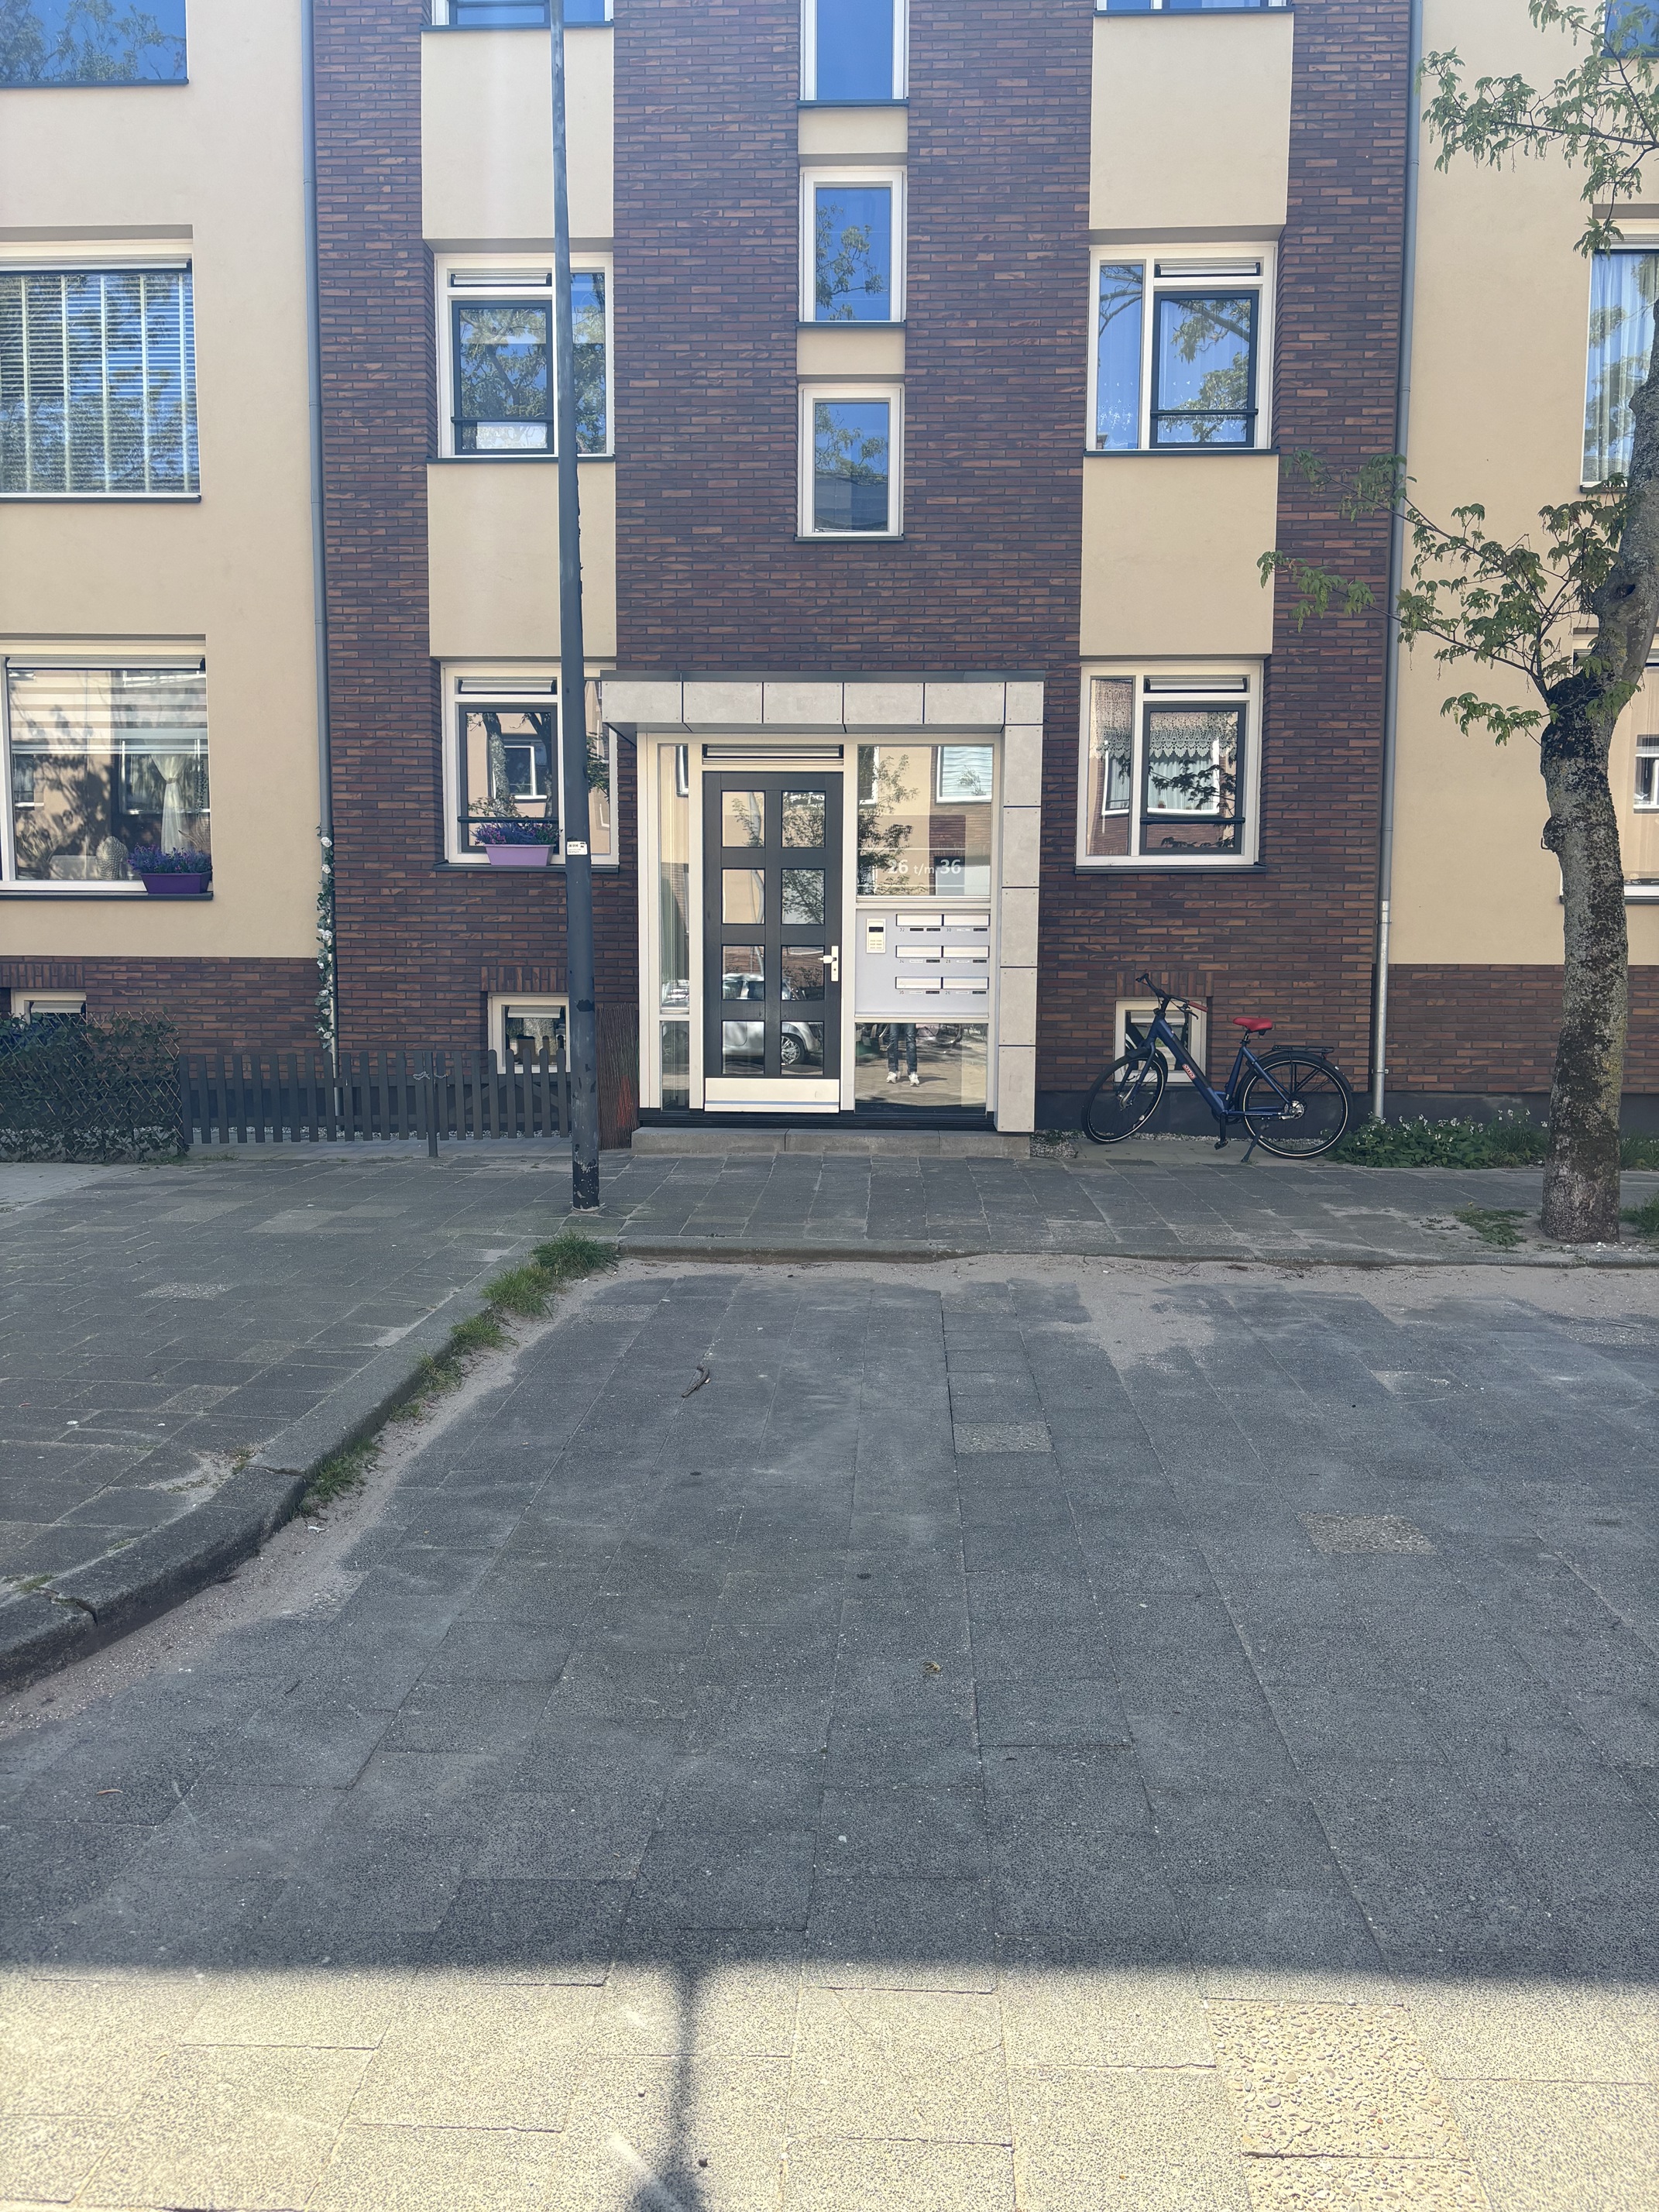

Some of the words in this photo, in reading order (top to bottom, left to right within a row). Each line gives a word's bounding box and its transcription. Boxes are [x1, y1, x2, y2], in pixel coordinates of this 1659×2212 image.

[888, 859, 908, 874] 26
[913, 864, 934, 876] t/m
[939, 859, 961, 874] 36
